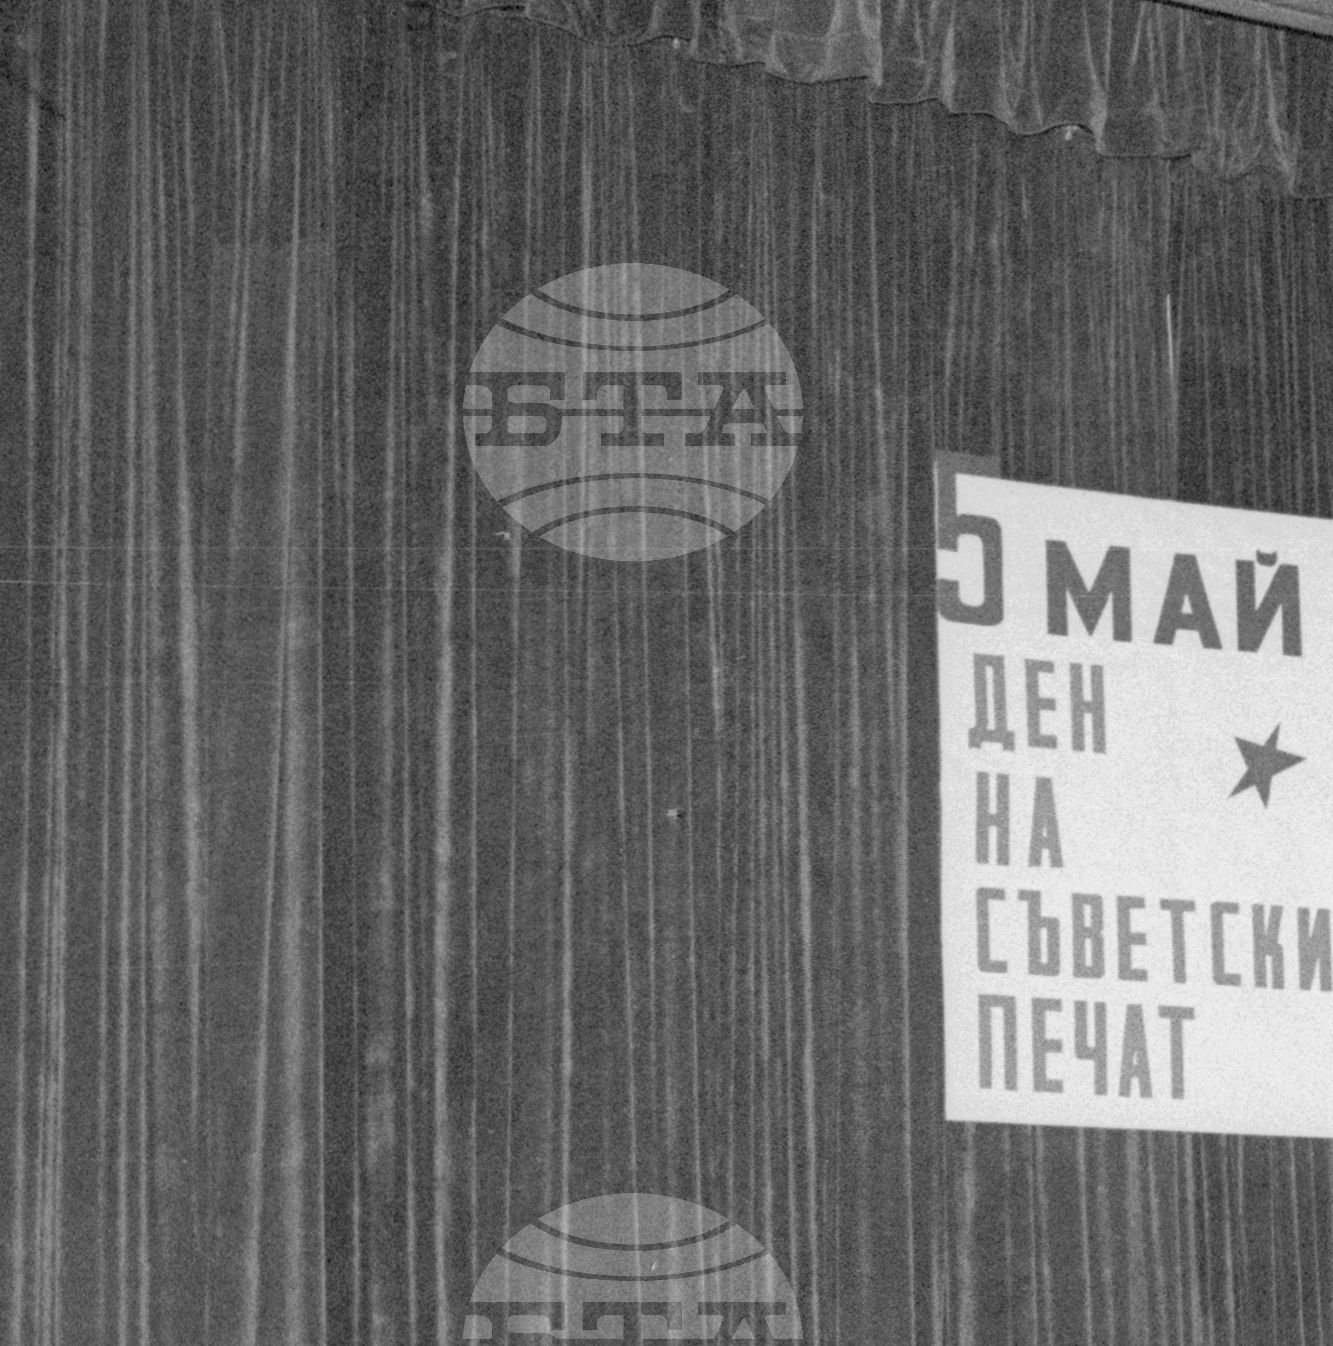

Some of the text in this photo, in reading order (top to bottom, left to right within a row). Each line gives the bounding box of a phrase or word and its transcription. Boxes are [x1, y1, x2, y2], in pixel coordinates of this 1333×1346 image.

[935, 450, 1304, 658] 5 МАЙ
[967, 652, 1107, 754] ДЕН
[975, 771, 1064, 868] НА
[977, 993, 1196, 1100] ПЕЧАТ
